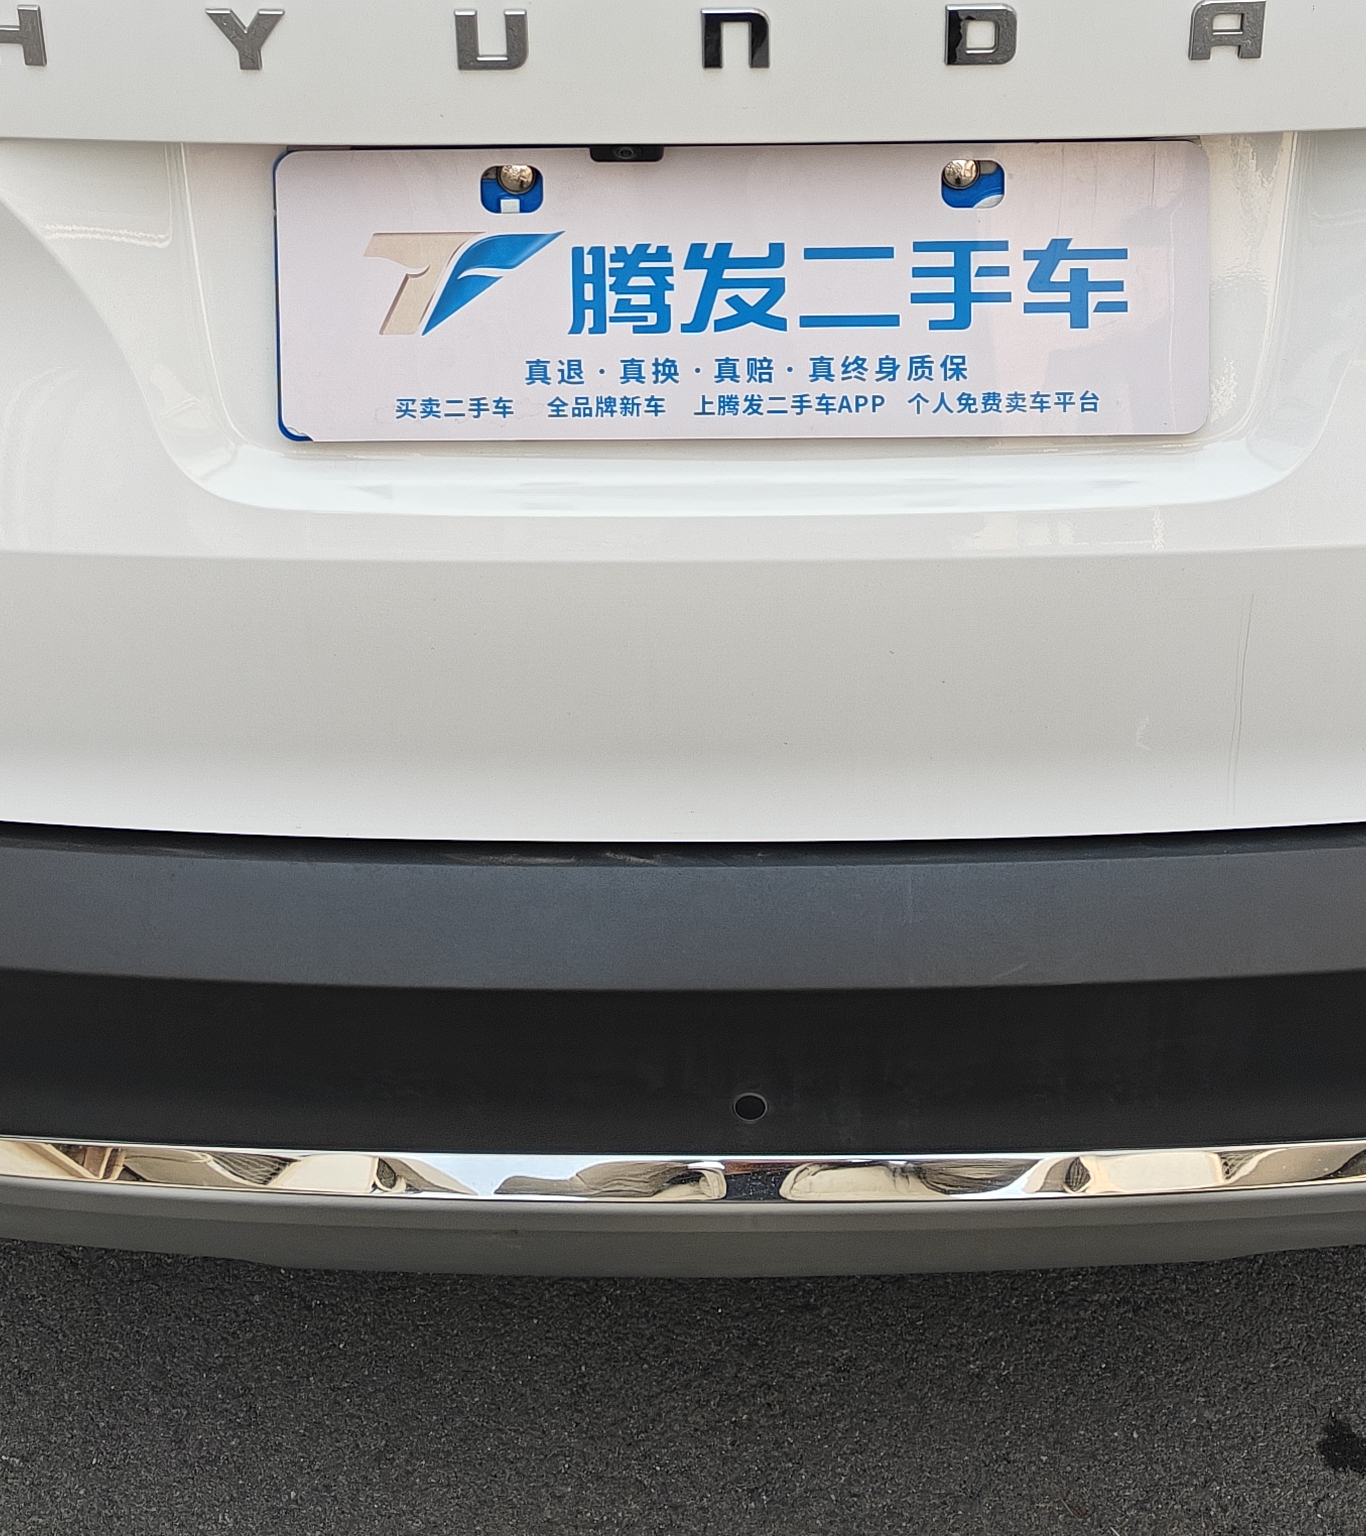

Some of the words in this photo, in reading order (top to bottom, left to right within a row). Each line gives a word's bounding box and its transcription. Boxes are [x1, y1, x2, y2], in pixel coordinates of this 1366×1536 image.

[567, 237, 1130, 336] 腾发二手车
[395, 396, 515, 419] 买卖二手车
[546, 394, 667, 418] 全品牌新车
[693, 392, 886, 417] 上腾发二手车APP
[906, 389, 1101, 415] 个人免费卖车平台
